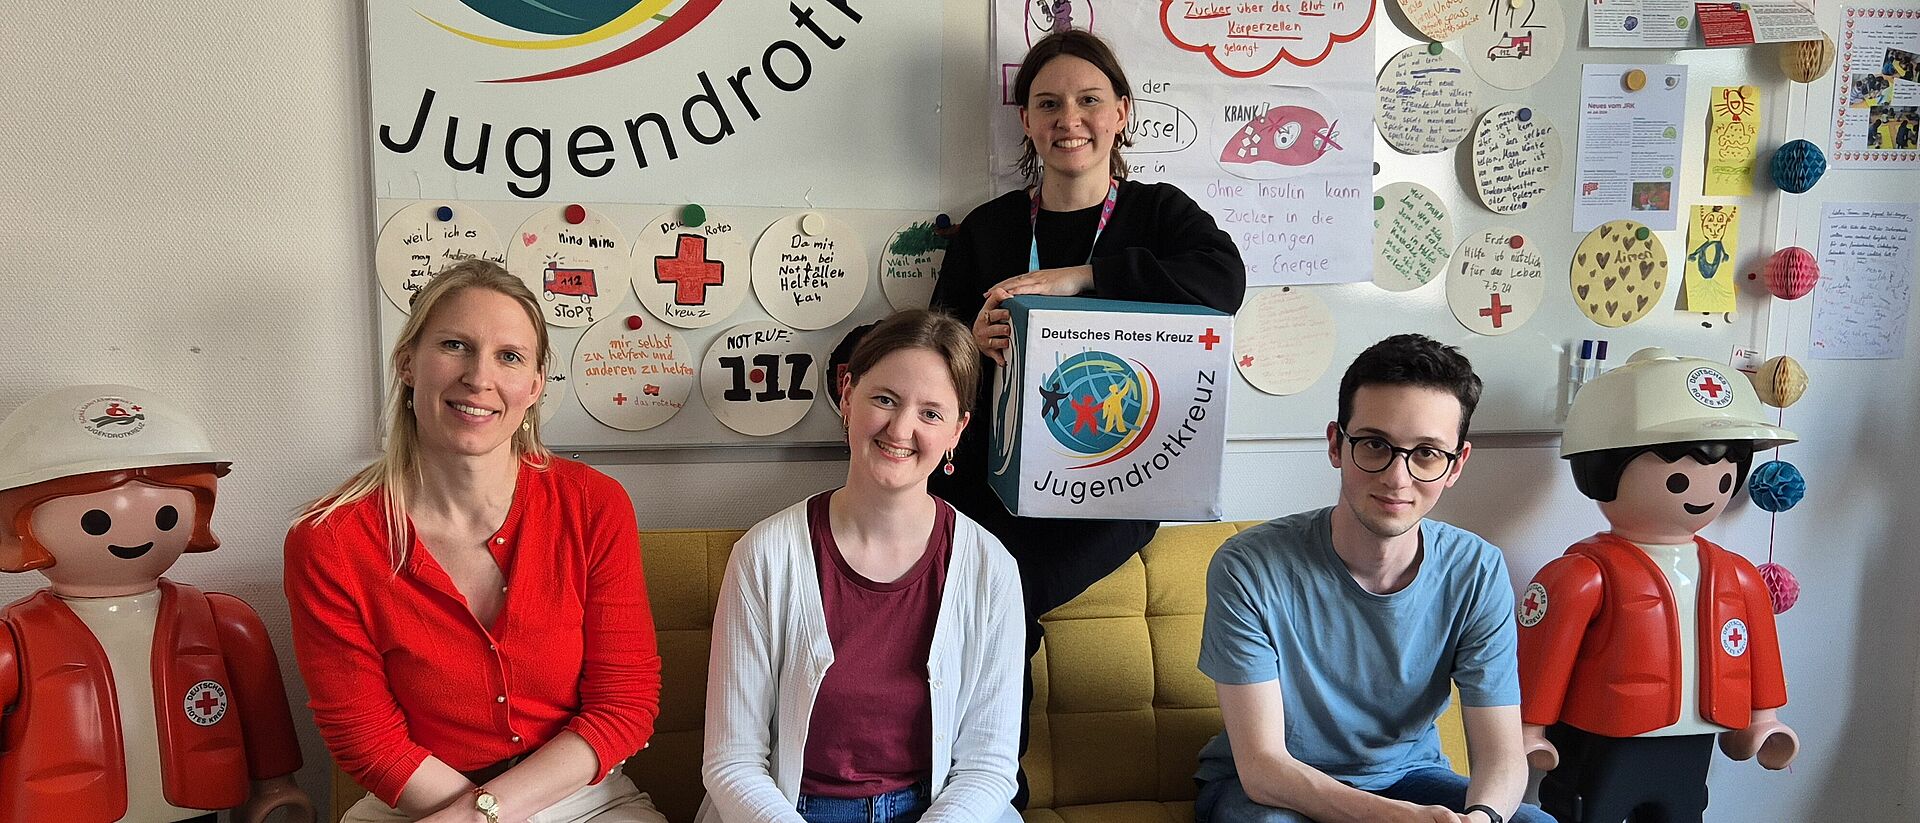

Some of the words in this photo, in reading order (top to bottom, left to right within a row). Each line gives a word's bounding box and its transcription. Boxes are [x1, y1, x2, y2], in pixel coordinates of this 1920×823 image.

[1184, 1, 1231, 15] Zucker
[1237, 2, 1266, 14] über
[1270, 1, 1292, 13] das
[1299, 2, 1325, 13] Blut
[1332, 1, 1345, 12] in
[1227, 20, 1302, 34] Körperzellen
[1223, 42, 1260, 57] gelangt
[1141, 80, 1171, 94] der
[1223, 102, 1270, 124] KRANK!
[1154, 161, 1167, 173] in
[1206, 180, 1244, 198] Ohne
[1258, 183, 1305, 199] Insulin
[1325, 180, 1360, 199] kann
[1223, 208, 1274, 223] Zucker
[1286, 213, 1298, 223] in
[1312, 210, 1335, 225] die
[403, 223, 433, 246] weil
[443, 224, 460, 239] ich
[465, 230, 477, 239] es
[704, 223, 732, 236] Rotes
[1243, 232, 1314, 250] gelangen
[1485, 233, 1510, 245] Erste
[818, 252, 835, 264] bei
[1464, 246, 1485, 260] Hilfe
[887, 256, 909, 267] Weil
[1273, 254, 1329, 276] Energie
[886, 266, 923, 278] Mensch
[1470, 264, 1485, 276] für
[1491, 267, 1502, 275] das
[1511, 267, 1542, 278] Leben
[560, 275, 583, 287] 112
[780, 277, 829, 292] Helfen
[554, 303, 594, 323] STOP!
[665, 303, 711, 318] Kreuz
[610, 335, 631, 349] mir
[638, 333, 672, 349] selbst
[1041, 327, 1111, 341] Deutsches
[1114, 330, 1152, 342] Rotes
[1156, 331, 1194, 343] Kreuz
[584, 352, 604, 362] zu
[608, 349, 648, 362] helfen
[653, 349, 674, 361] und
[586, 361, 637, 376] anderen
[641, 364, 658, 374] zu
[663, 362, 694, 378] helfen
[1689, 369, 1727, 385] DEUTSCHES
[634, 395, 648, 407] das
[1692, 388, 1714, 406] ROTES
[1716, 389, 1731, 406] KREUZ
[85, 422, 145, 438] JUGENDROTKREUZ
[1034, 370, 1216, 505] Jugendrotkreuz
[187, 682, 224, 701] DEUTSCHES
[187, 706, 207, 724] ROTES
[208, 702, 226, 724] KREUZ
